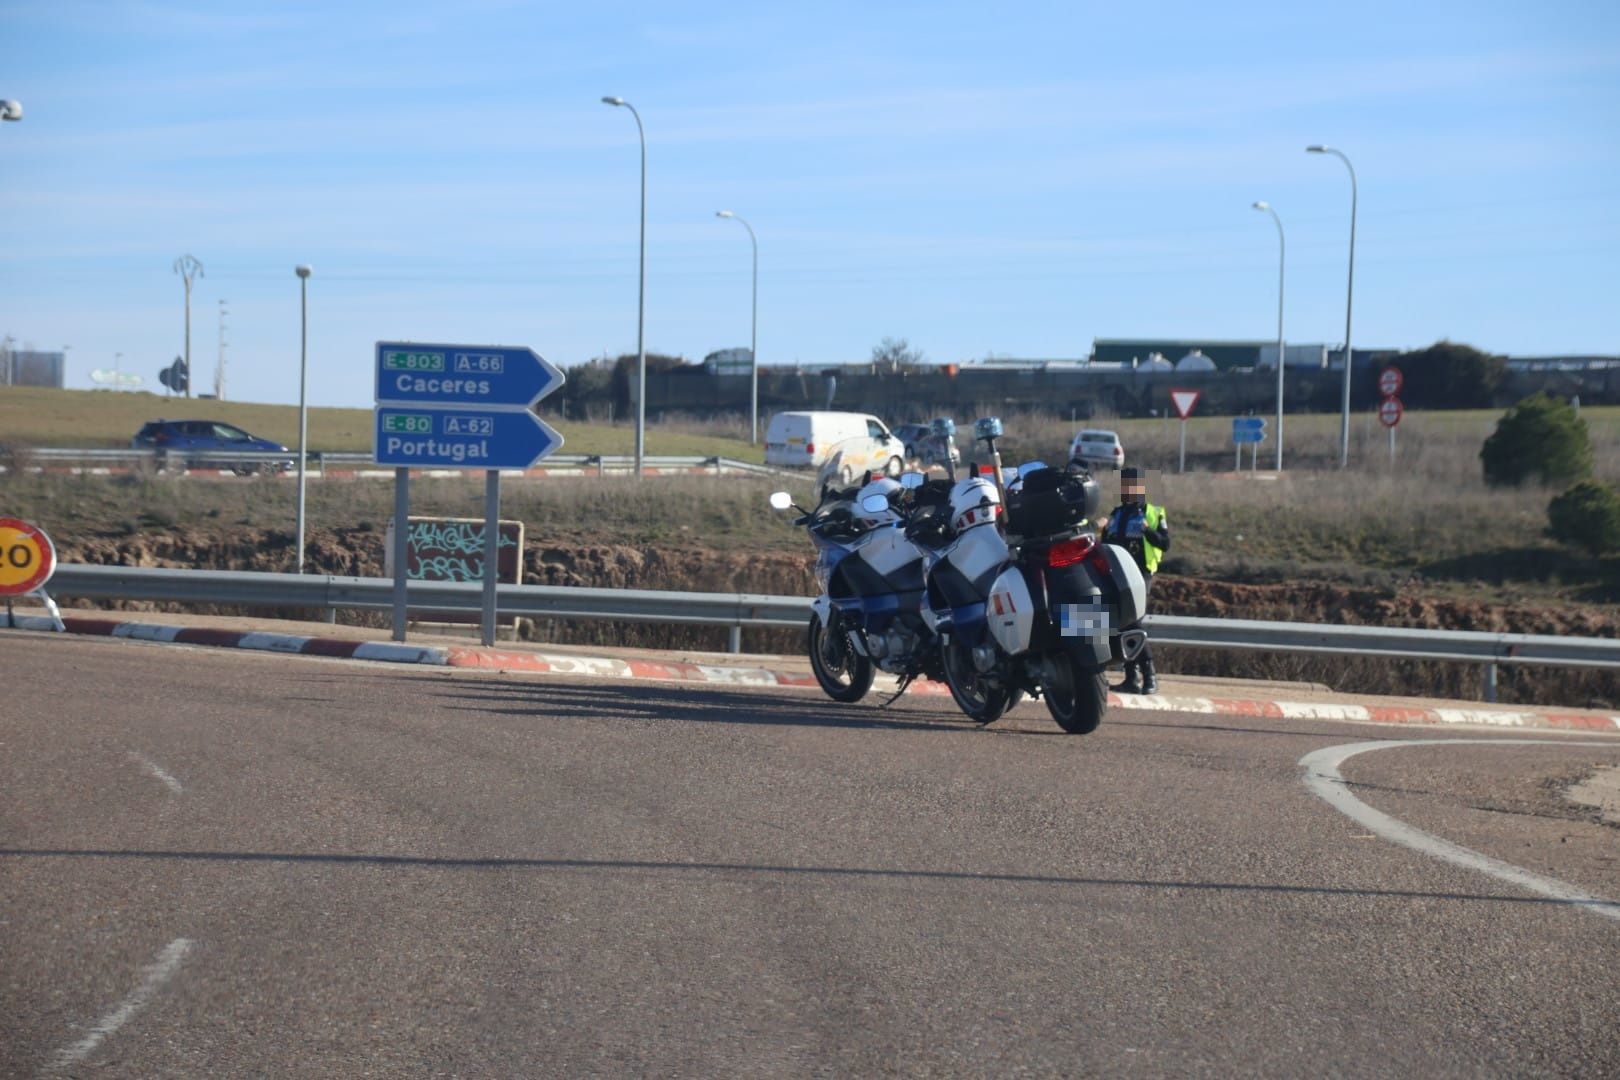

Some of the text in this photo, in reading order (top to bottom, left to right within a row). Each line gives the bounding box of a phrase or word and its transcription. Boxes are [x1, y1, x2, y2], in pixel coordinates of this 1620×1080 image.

[385, 353, 502, 371] E-803 A-66
[396, 374, 490, 395] Caceres
[384, 416, 491, 434] E-80 A-62
[387, 438, 489, 461] Portugal
[0, 544, 32, 568] 0
